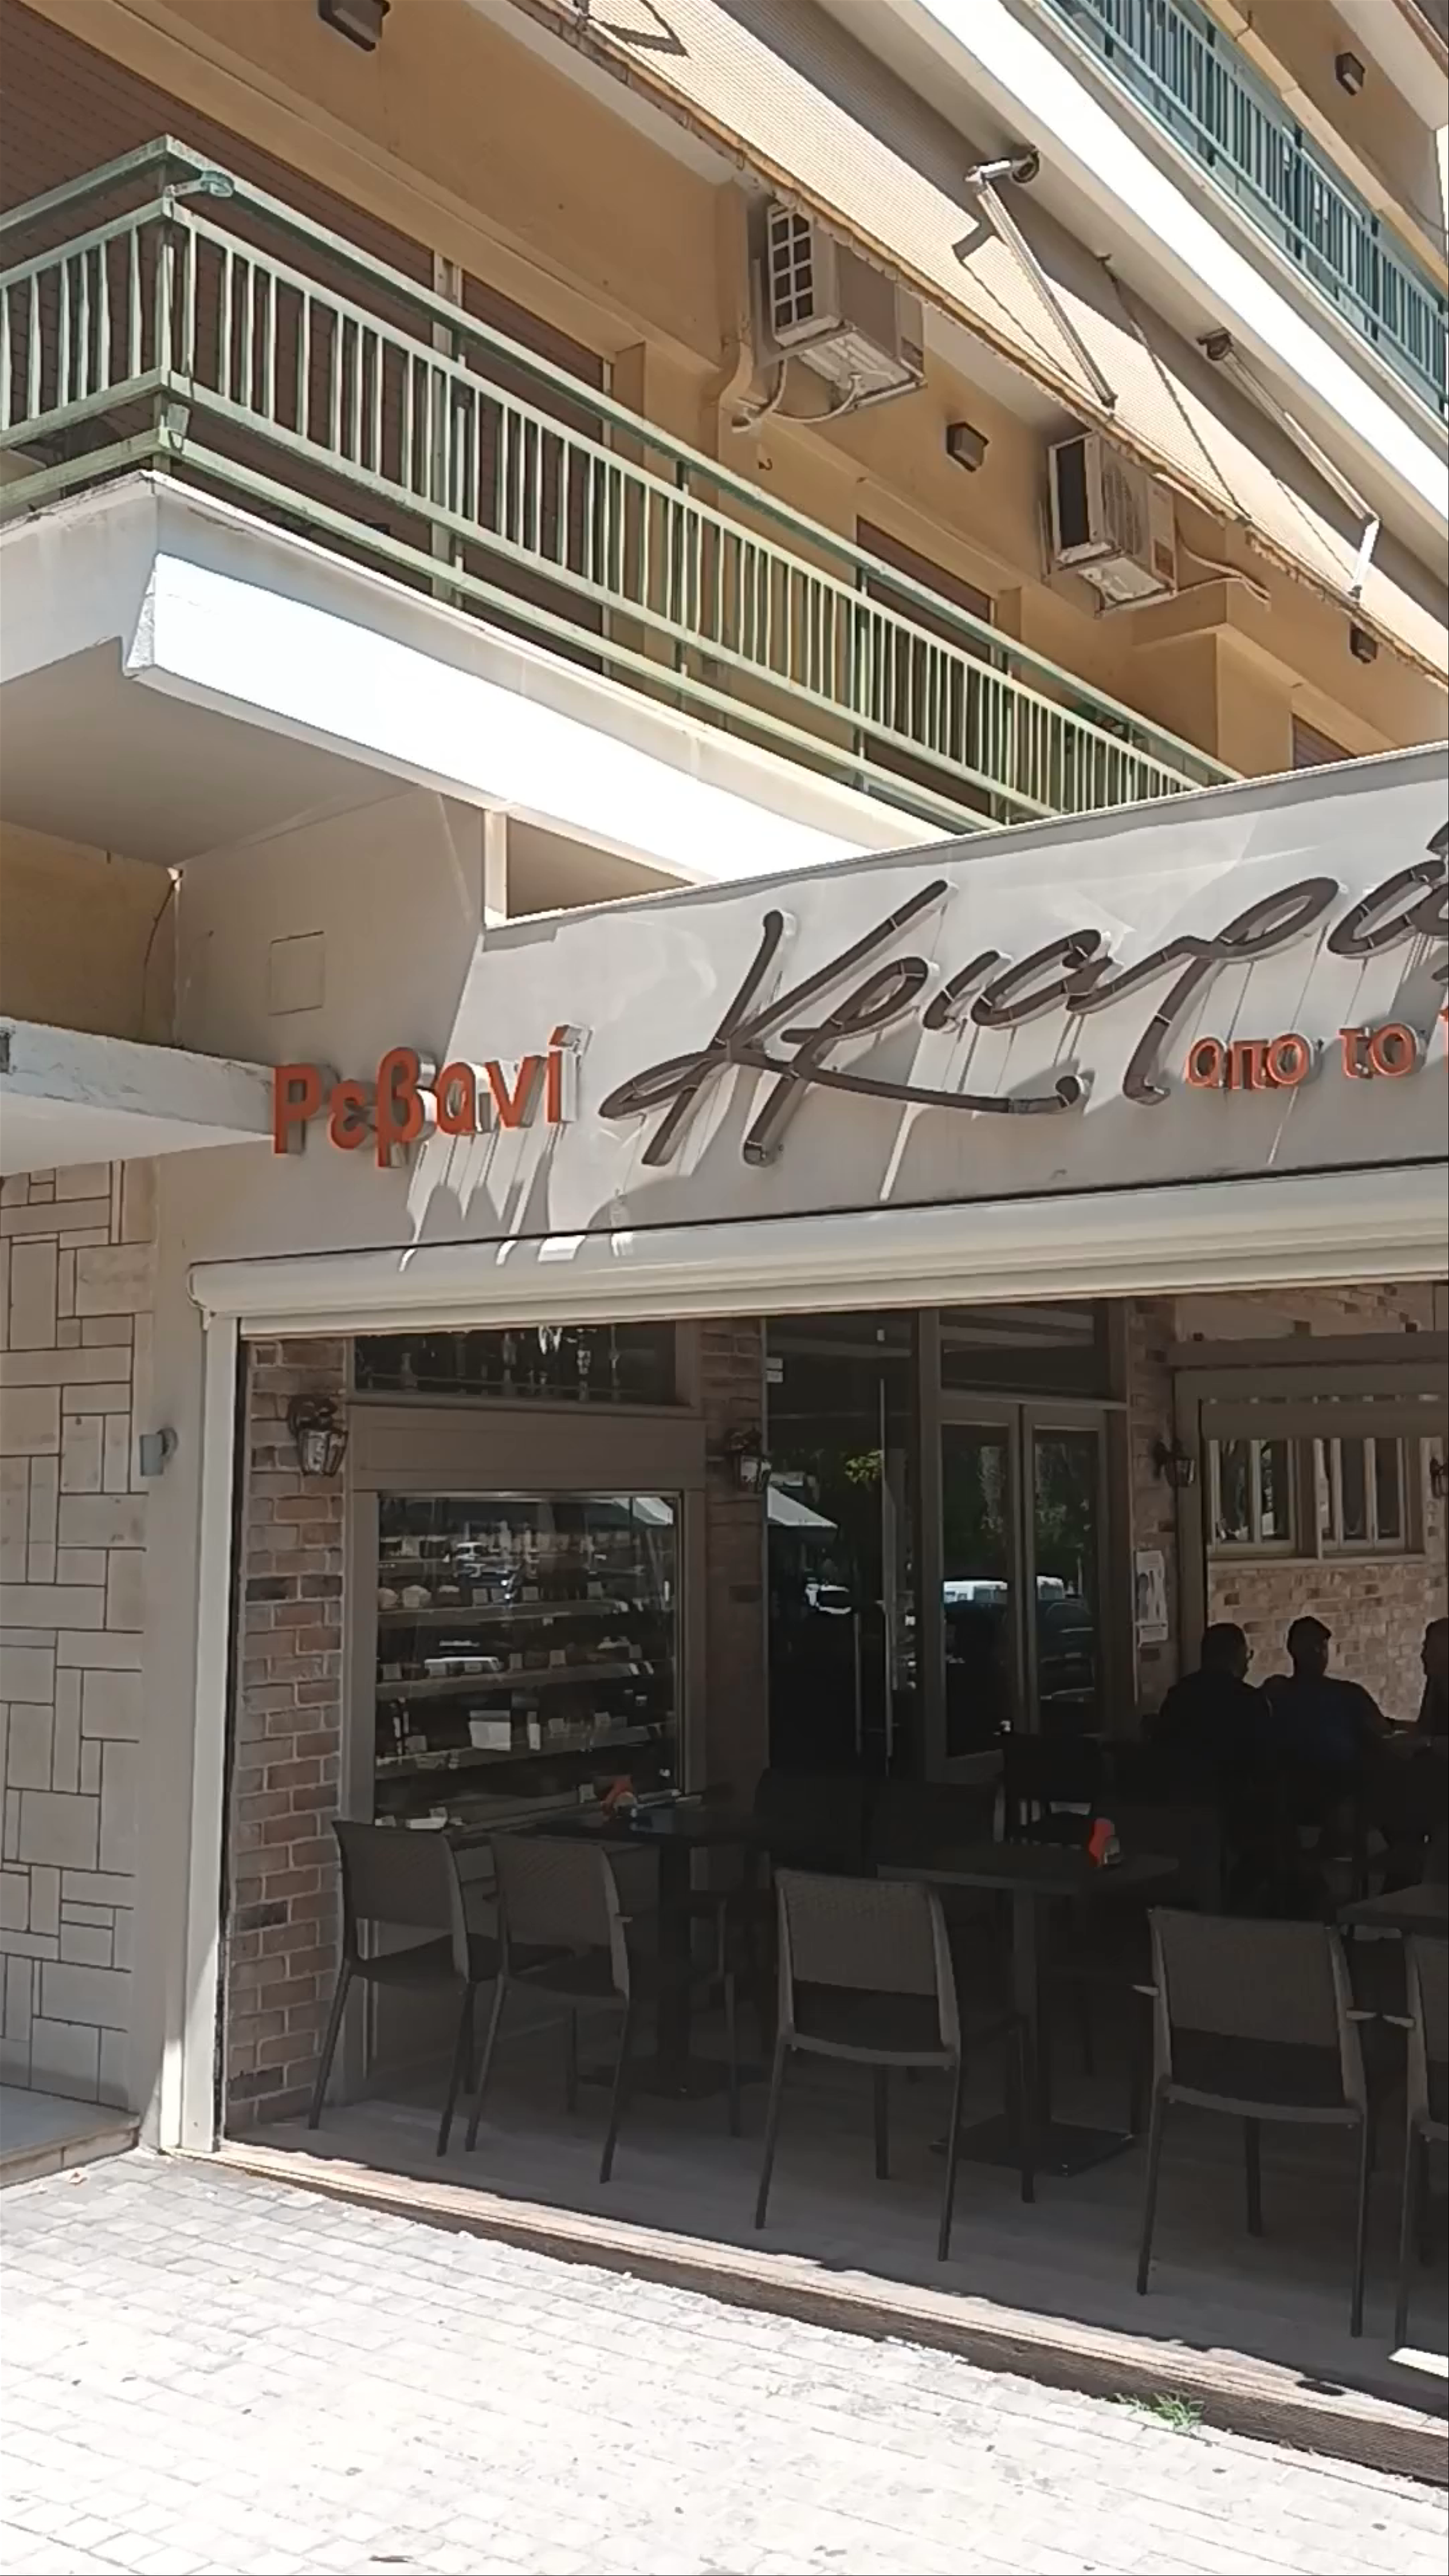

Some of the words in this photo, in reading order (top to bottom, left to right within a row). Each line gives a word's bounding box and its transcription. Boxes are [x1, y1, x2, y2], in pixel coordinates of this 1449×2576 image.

[273, 1024, 577, 1168] Ρεβανί
[1185, 1035, 1313, 1090] απο
[1338, 1022, 1419, 1079] το
